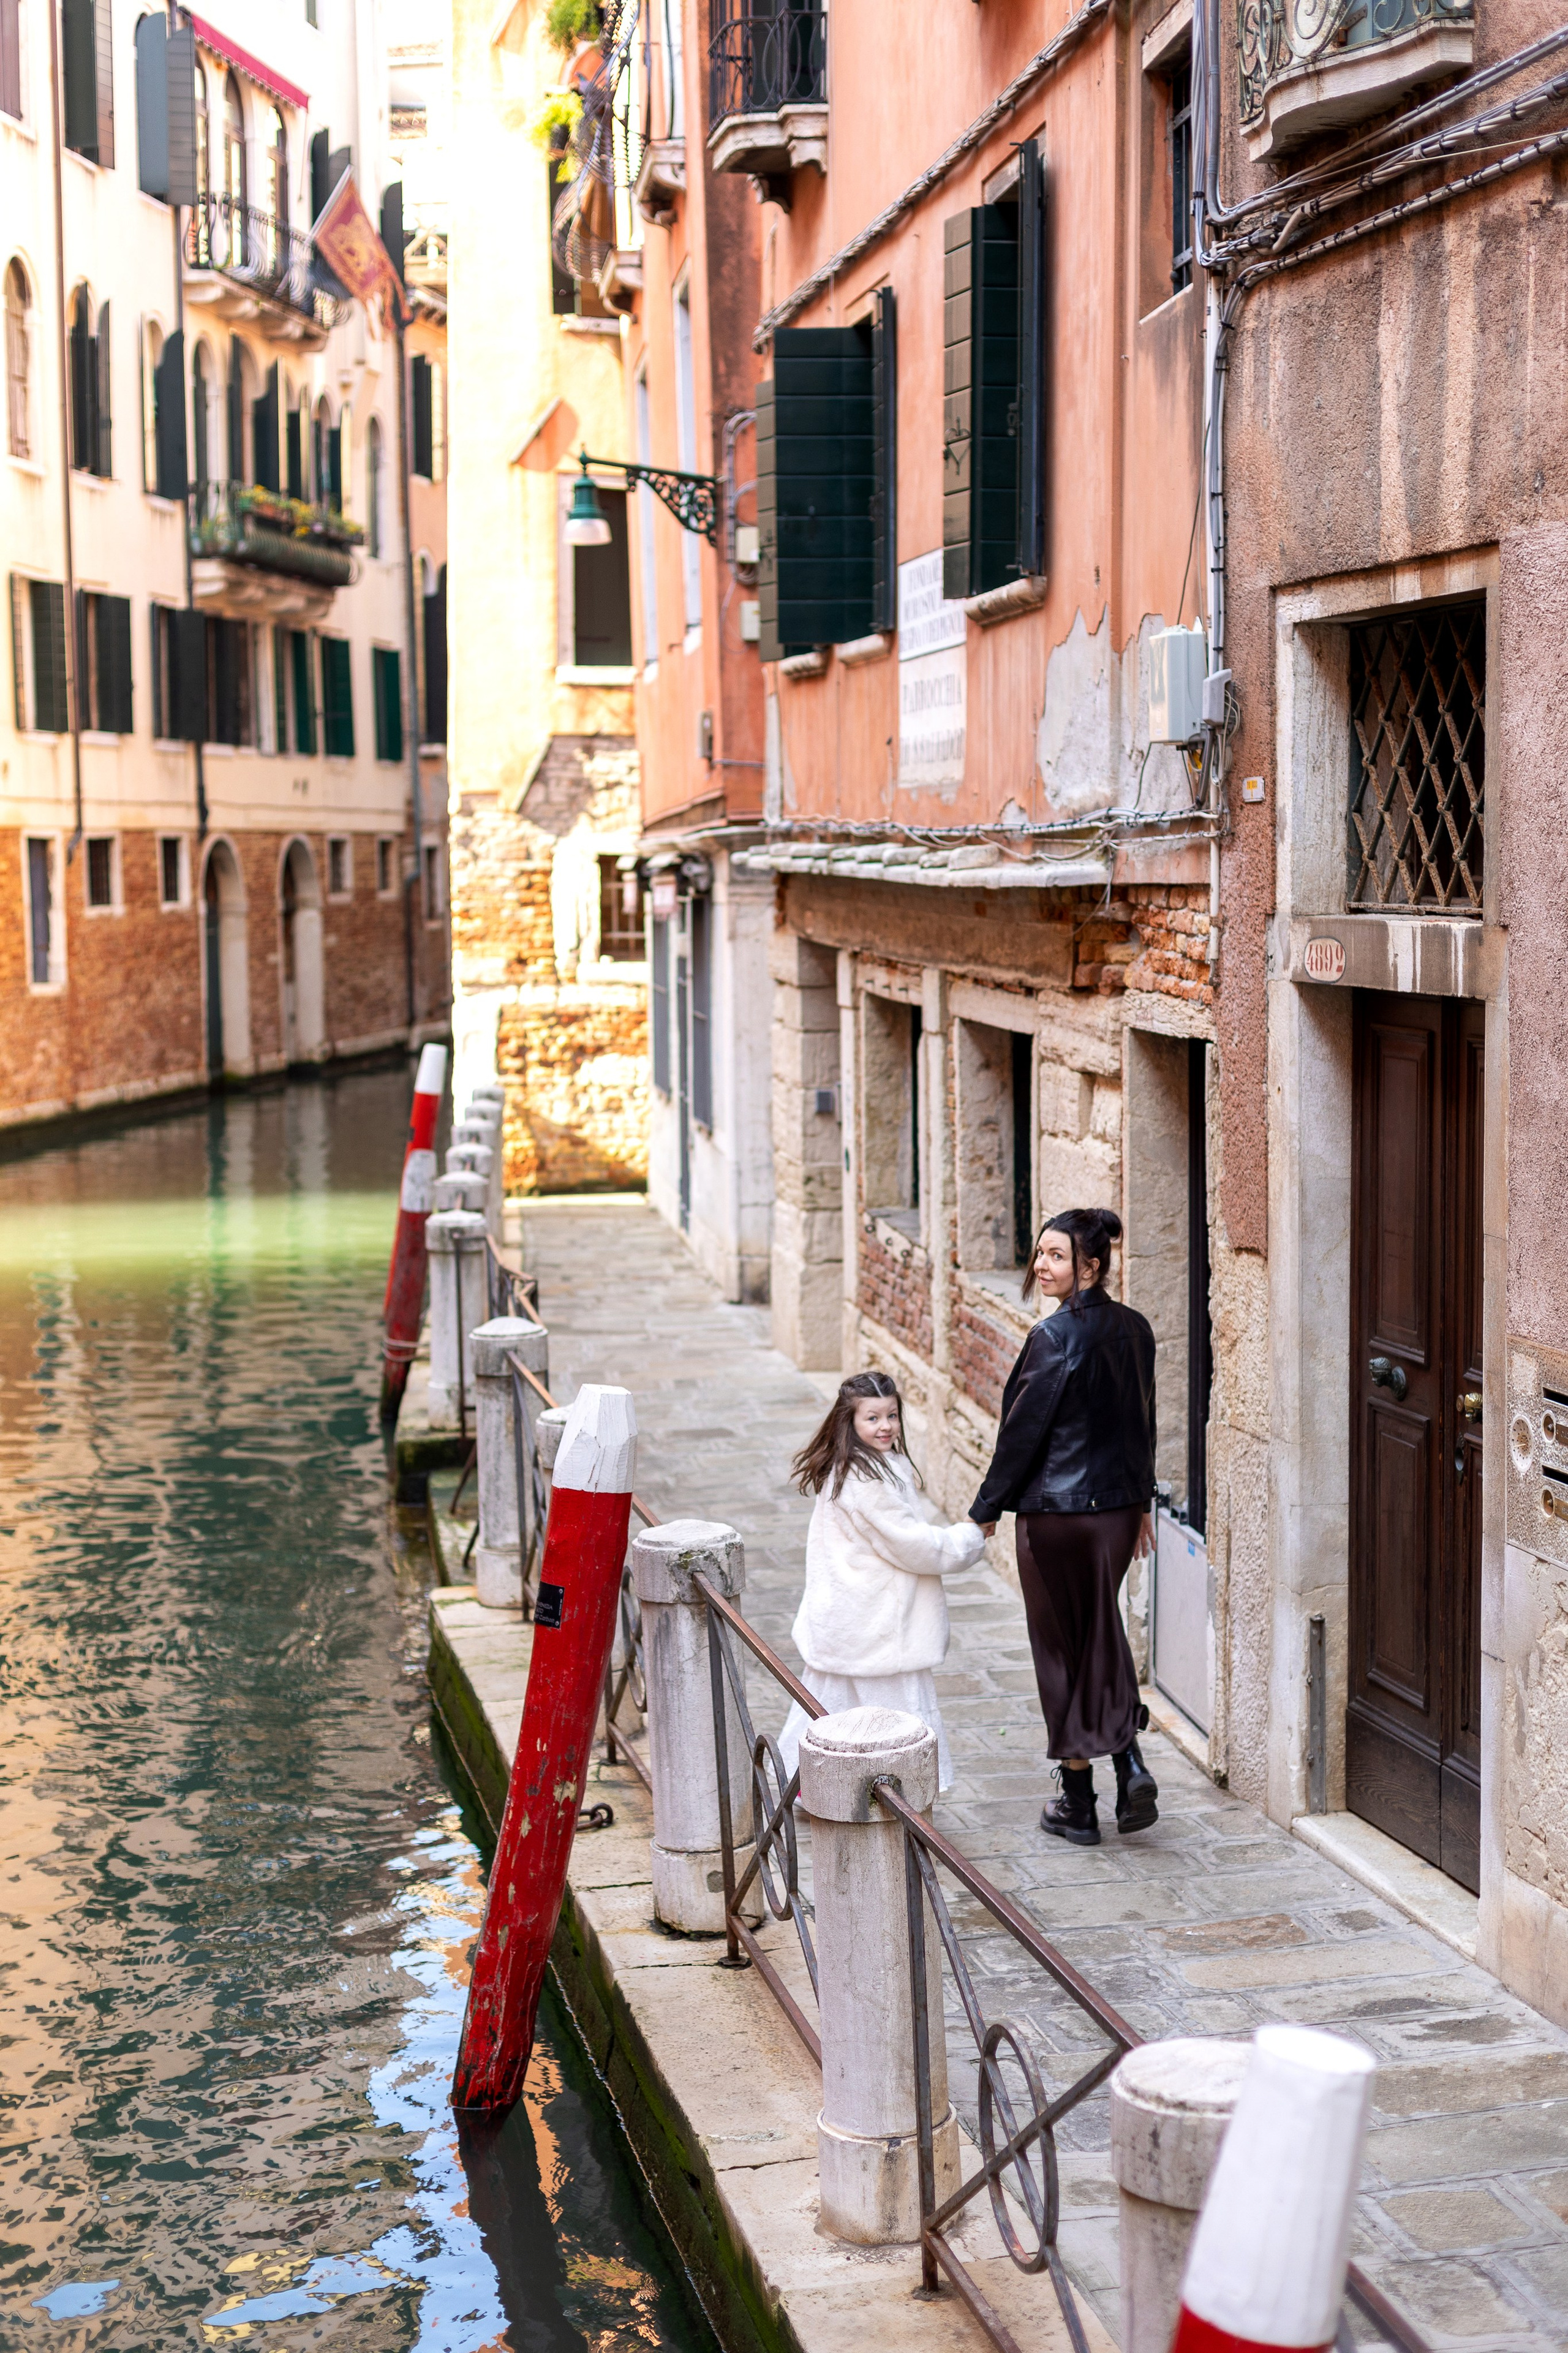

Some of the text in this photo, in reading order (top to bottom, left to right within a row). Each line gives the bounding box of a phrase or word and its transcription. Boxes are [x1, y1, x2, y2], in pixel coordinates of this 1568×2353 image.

[908, 557, 940, 592] FONDAME
[903, 674, 962, 714] PARROCCHIA
[1306, 944, 1344, 973] 4892
